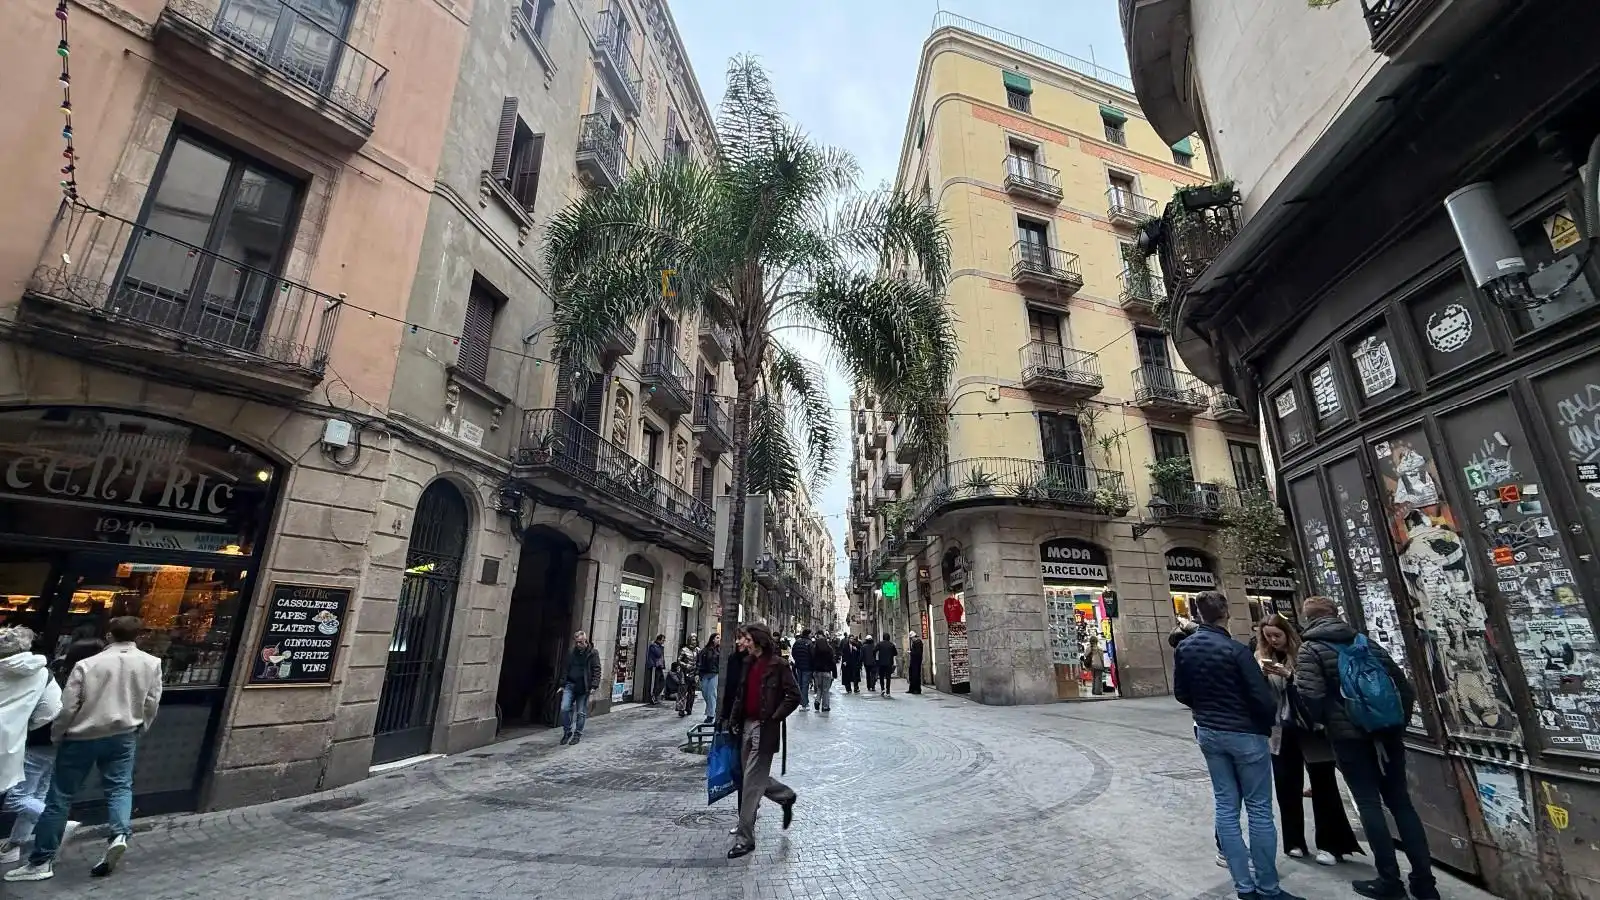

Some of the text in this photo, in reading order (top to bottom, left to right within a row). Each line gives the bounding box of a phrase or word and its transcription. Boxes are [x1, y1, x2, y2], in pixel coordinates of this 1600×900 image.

[94, 516, 155, 537] 1940
[1047, 546, 1091, 560] MODA
[1165, 555, 1202, 568] MODA
[1041, 565, 1104, 577] BARCELONA
[1168, 573, 1213, 584] ARCELONA
[277, 599, 339, 610] CASSOLETES
[274, 611, 308, 620] TAPES
[270, 623, 316, 633] PLATETS
[284, 639, 332, 648] GINTONICS
[293, 651, 330, 660] SPRITZ
[302, 663, 327, 672] VINS
